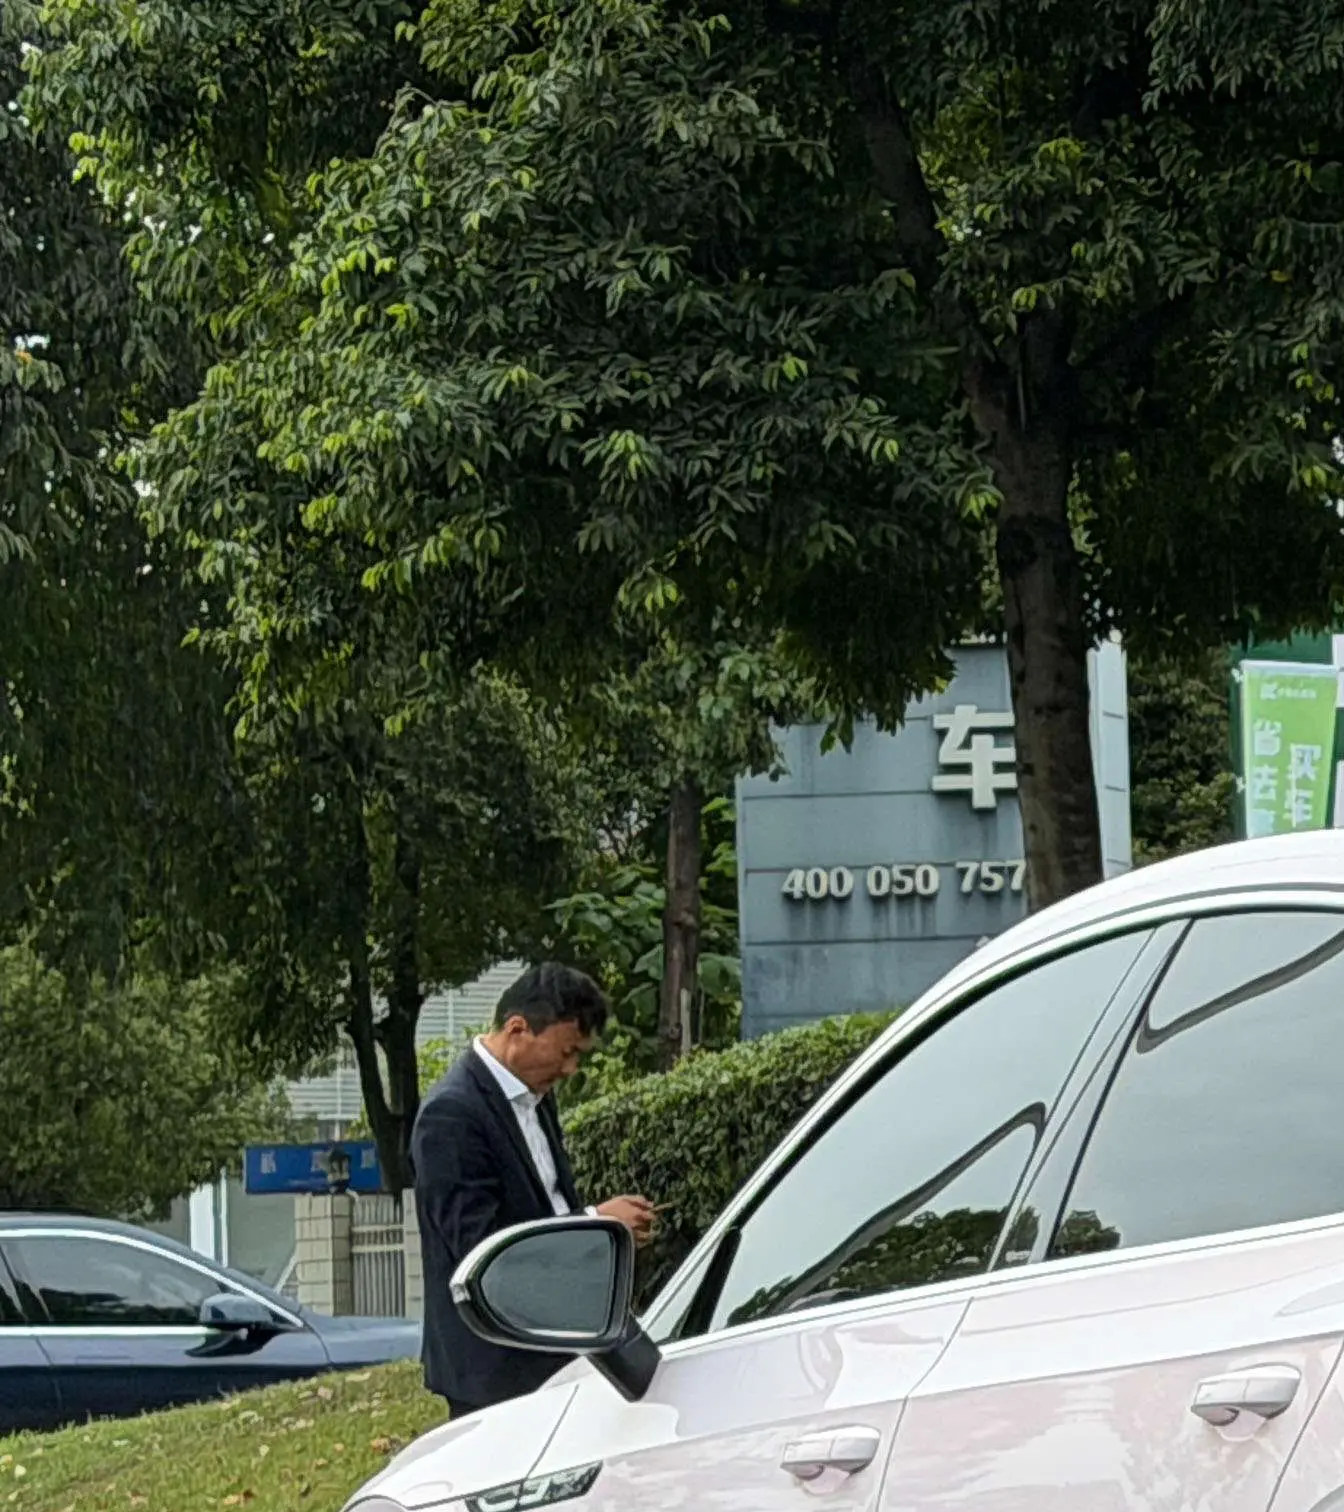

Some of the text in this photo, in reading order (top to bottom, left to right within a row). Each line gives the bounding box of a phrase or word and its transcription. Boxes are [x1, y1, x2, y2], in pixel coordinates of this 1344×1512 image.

[931, 703, 1019, 810] 车
[781, 865, 854, 900] 400
[866, 864, 939, 897] 050
